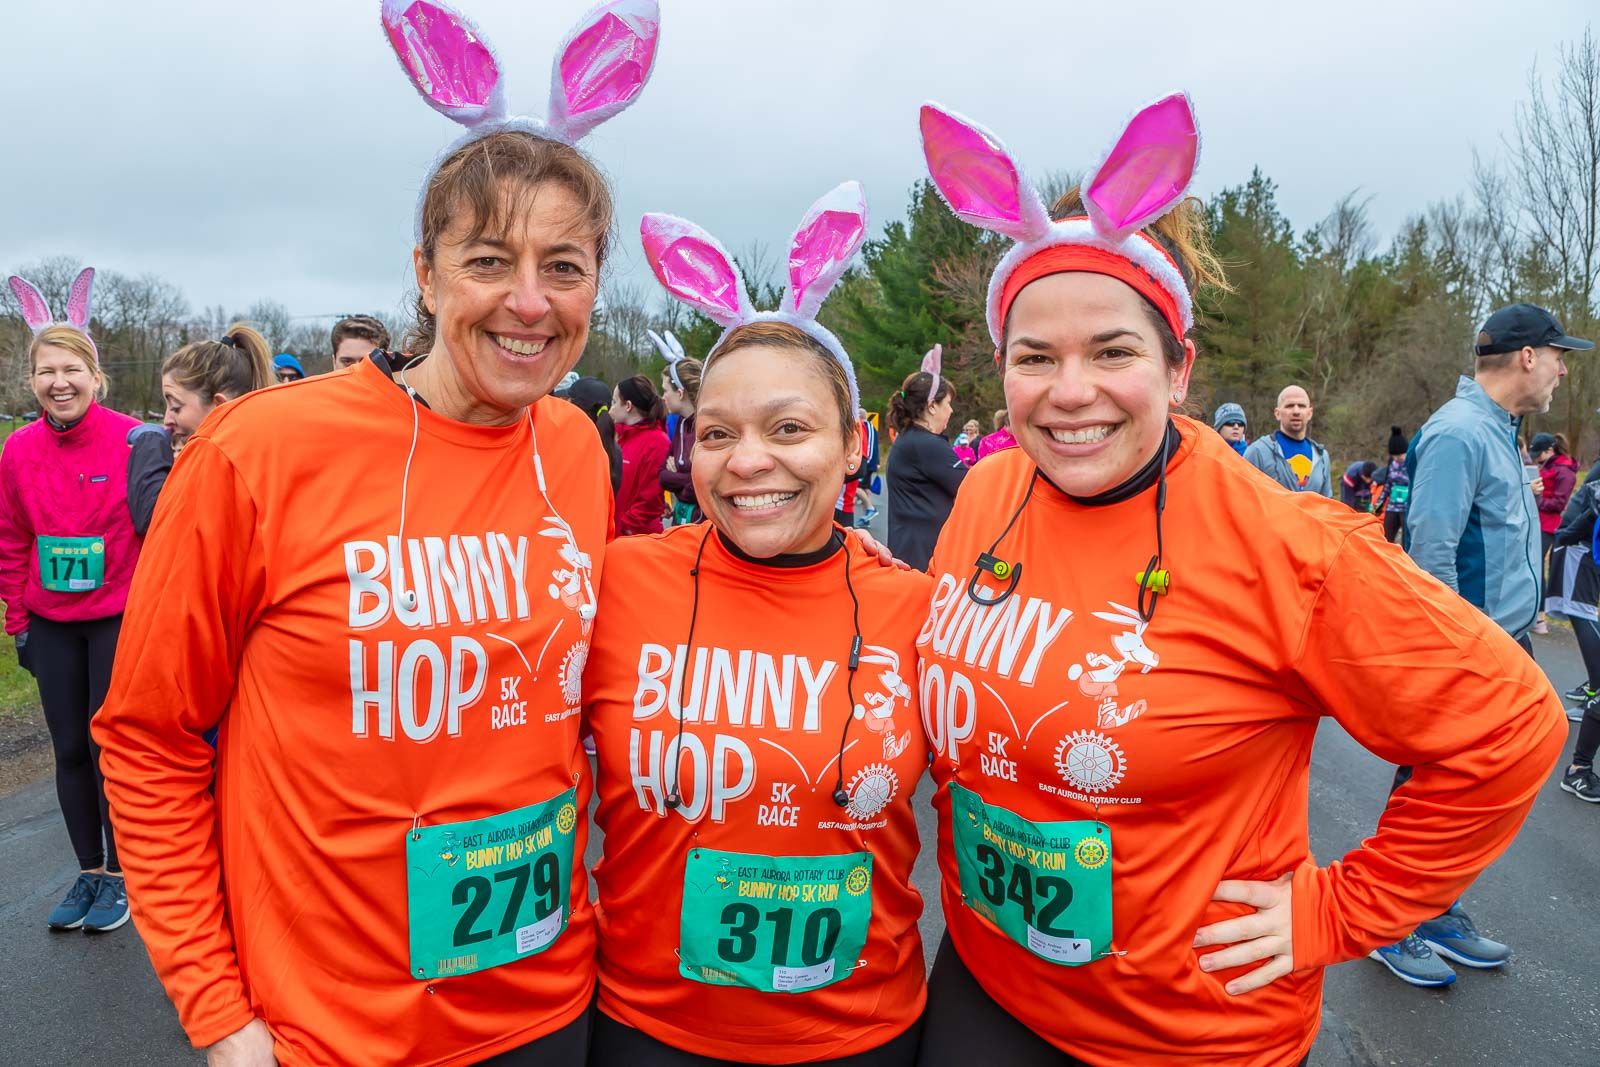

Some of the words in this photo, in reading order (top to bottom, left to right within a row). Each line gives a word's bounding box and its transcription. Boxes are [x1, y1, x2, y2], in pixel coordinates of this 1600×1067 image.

[49, 556, 88, 580] 171
[343, 531, 531, 631] BUNNY
[916, 573, 1074, 688] BUNNY
[350, 635, 488, 744] HOP
[500, 676, 521, 701] 5K
[632, 643, 840, 733] BUNNY
[491, 701, 527, 730] RACE
[544, 713, 561, 723] EAST
[918, 656, 977, 766] OP
[988, 731, 1009, 758] 5K
[629, 727, 757, 824] HOP
[980, 754, 1018, 783] RACE
[770, 782, 796, 805] 5K
[1039, 783, 1056, 794] EAST
[1057, 788, 1088, 802] AURORA
[1089, 795, 1119, 804] ROTARY
[757, 805, 800, 828] RACE
[464, 834, 484, 848] EAST
[488, 826, 517, 844] AURORA
[466, 845, 505, 871] BUNNY
[505, 839, 524, 862] HOP
[525, 832, 537, 855] 5K
[536, 825, 553, 850] RUN
[1049, 837, 1071, 850] CLUB
[1007, 839, 1026, 860] HOP
[1026, 847, 1041, 869] 5K
[1042, 851, 1066, 871] RUN
[738, 866, 758, 878] EAST
[761, 868, 791, 882] AURORA
[794, 869, 824, 882] ROTARY
[827, 869, 845, 880] CLUB
[451, 851, 560, 948] 279
[738, 880, 776, 899] BUNNY
[777, 884, 800, 902] HOP
[801, 884, 818, 902] 5K
[818, 883, 840, 902] RUN
[976, 843, 1075, 939] 342
[717, 902, 842, 966] 310
